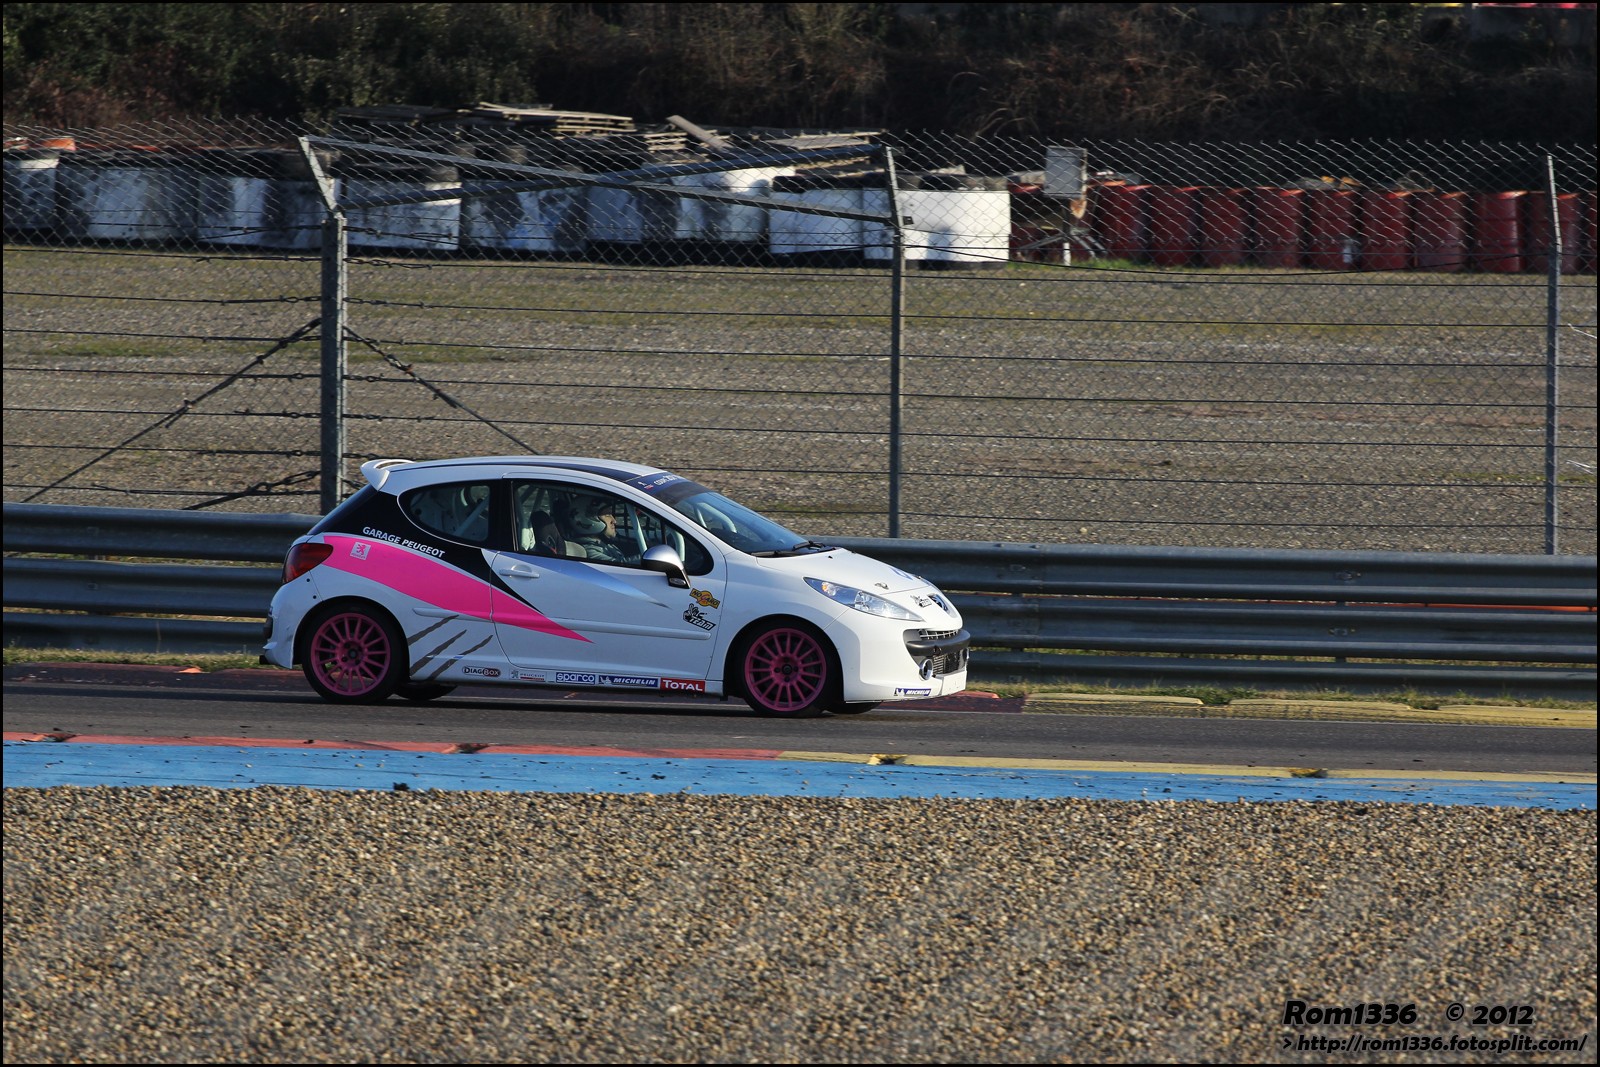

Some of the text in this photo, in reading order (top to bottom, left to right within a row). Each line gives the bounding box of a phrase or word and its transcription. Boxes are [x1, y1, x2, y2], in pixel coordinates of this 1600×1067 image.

[362, 526, 446, 559] GARAGE PEUGEOT
[556, 672, 595, 683] sparco
[613, 677, 656, 686] MICHELIN
[662, 679, 703, 691] TOTAL
